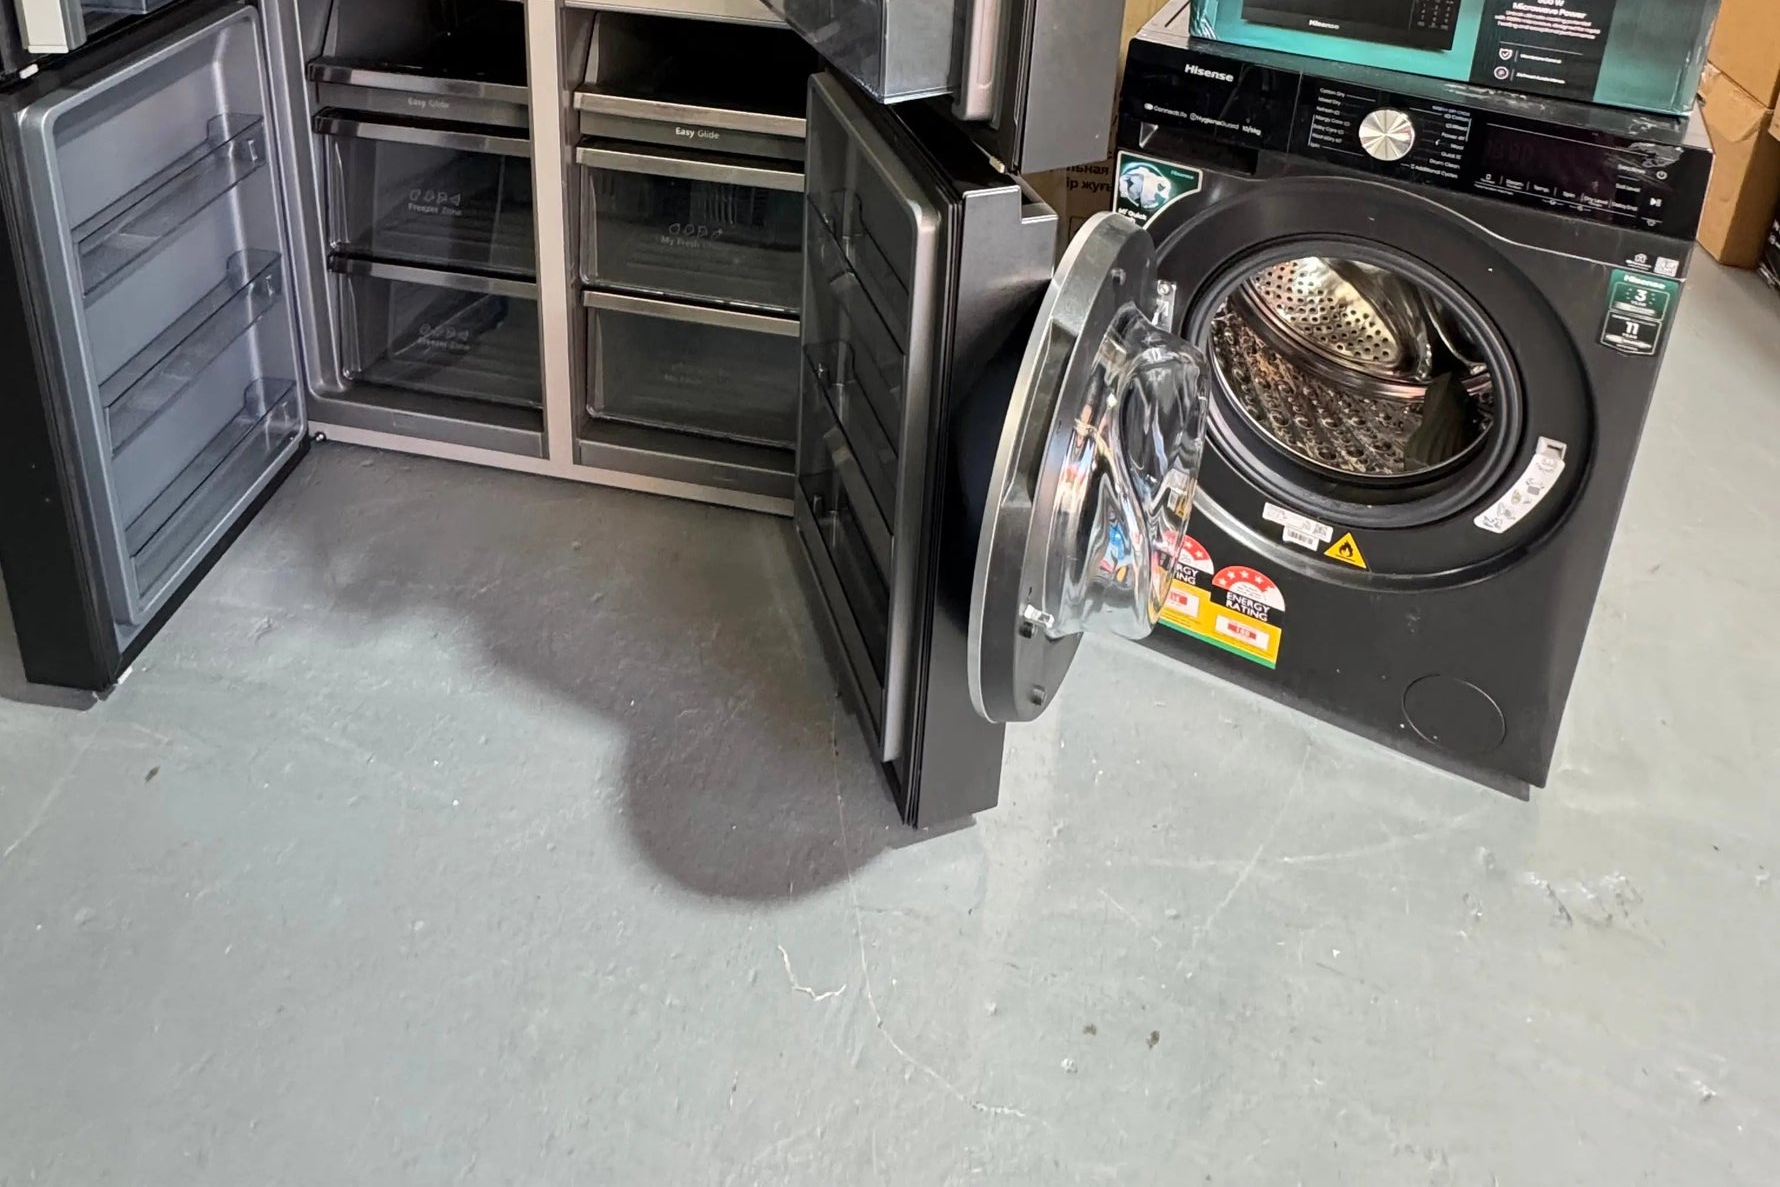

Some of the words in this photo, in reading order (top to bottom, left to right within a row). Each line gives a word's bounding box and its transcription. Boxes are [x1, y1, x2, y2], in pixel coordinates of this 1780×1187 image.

[1308, 19, 1340, 30] Hisense
[1184, 63, 1234, 82] Hisense
[407, 97, 426, 108] Easy
[675, 126, 695, 138] Easy
[697, 129, 720, 139] Glide
[408, 202, 439, 214] Freezer
[441, 206, 462, 216] Zone
[660, 235, 673, 246] My
[1634, 289, 1648, 302] 3
[1626, 321, 1640, 334] 11
[1227, 591, 1271, 614] ENERGY
[1226, 600, 1268, 622] RATING
